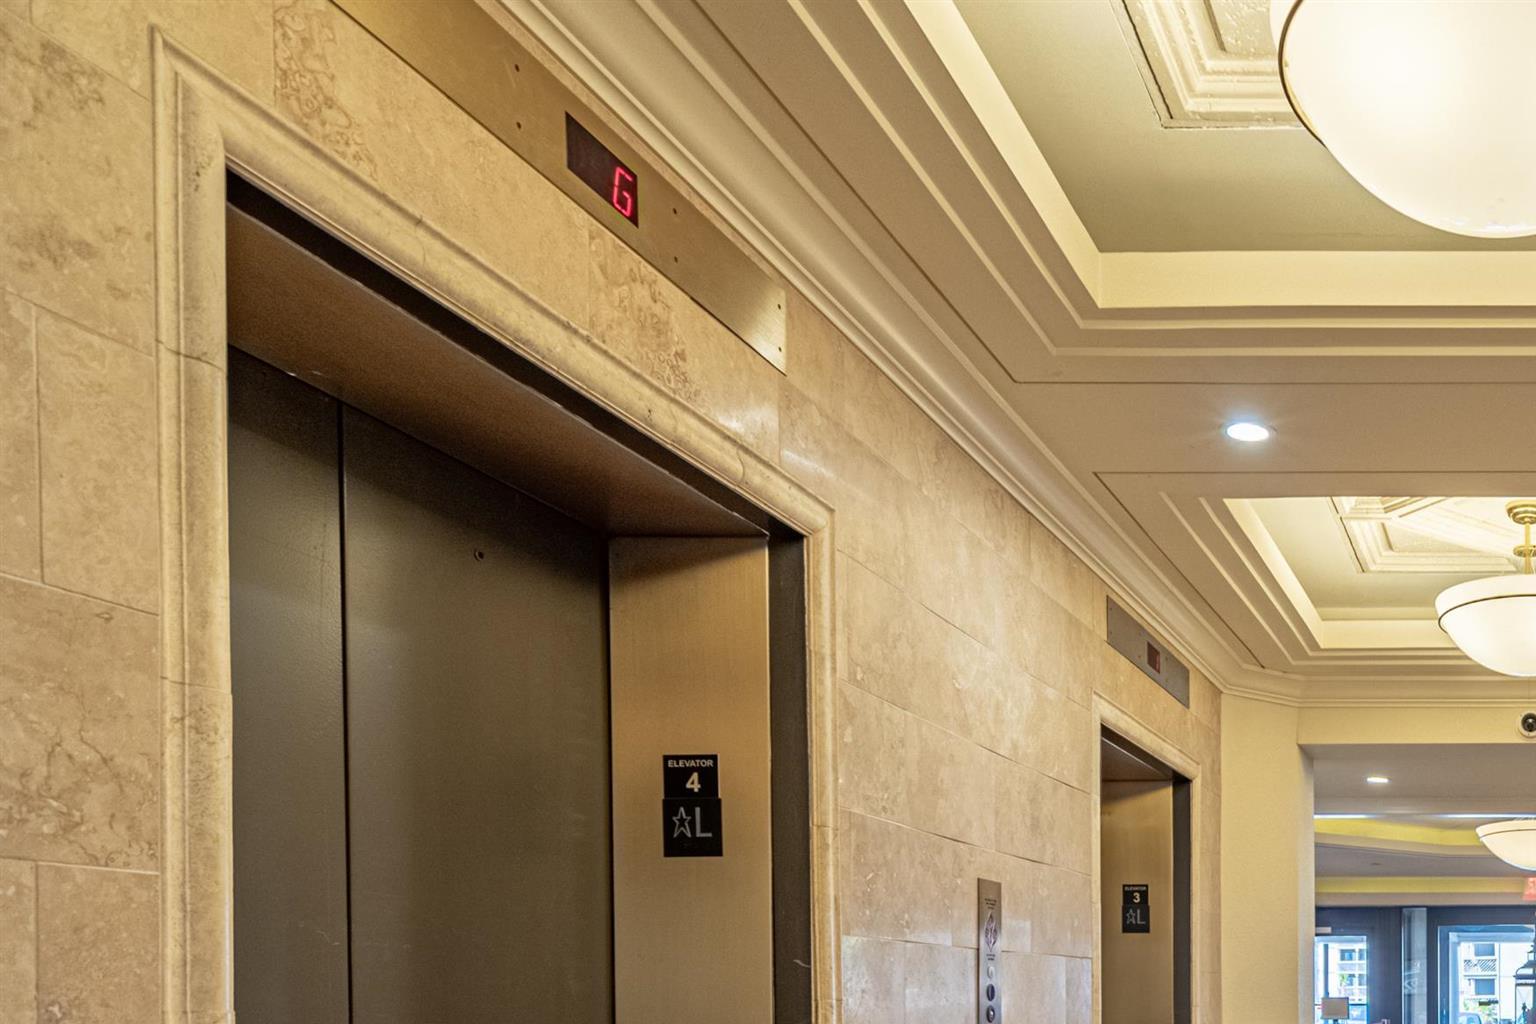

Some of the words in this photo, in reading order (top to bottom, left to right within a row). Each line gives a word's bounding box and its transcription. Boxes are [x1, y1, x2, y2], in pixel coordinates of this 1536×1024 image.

[667, 759, 714, 768] ELEVATOR
[685, 772, 701, 793] 4
[694, 806, 713, 838] L
[1132, 892, 1141, 904] 3
